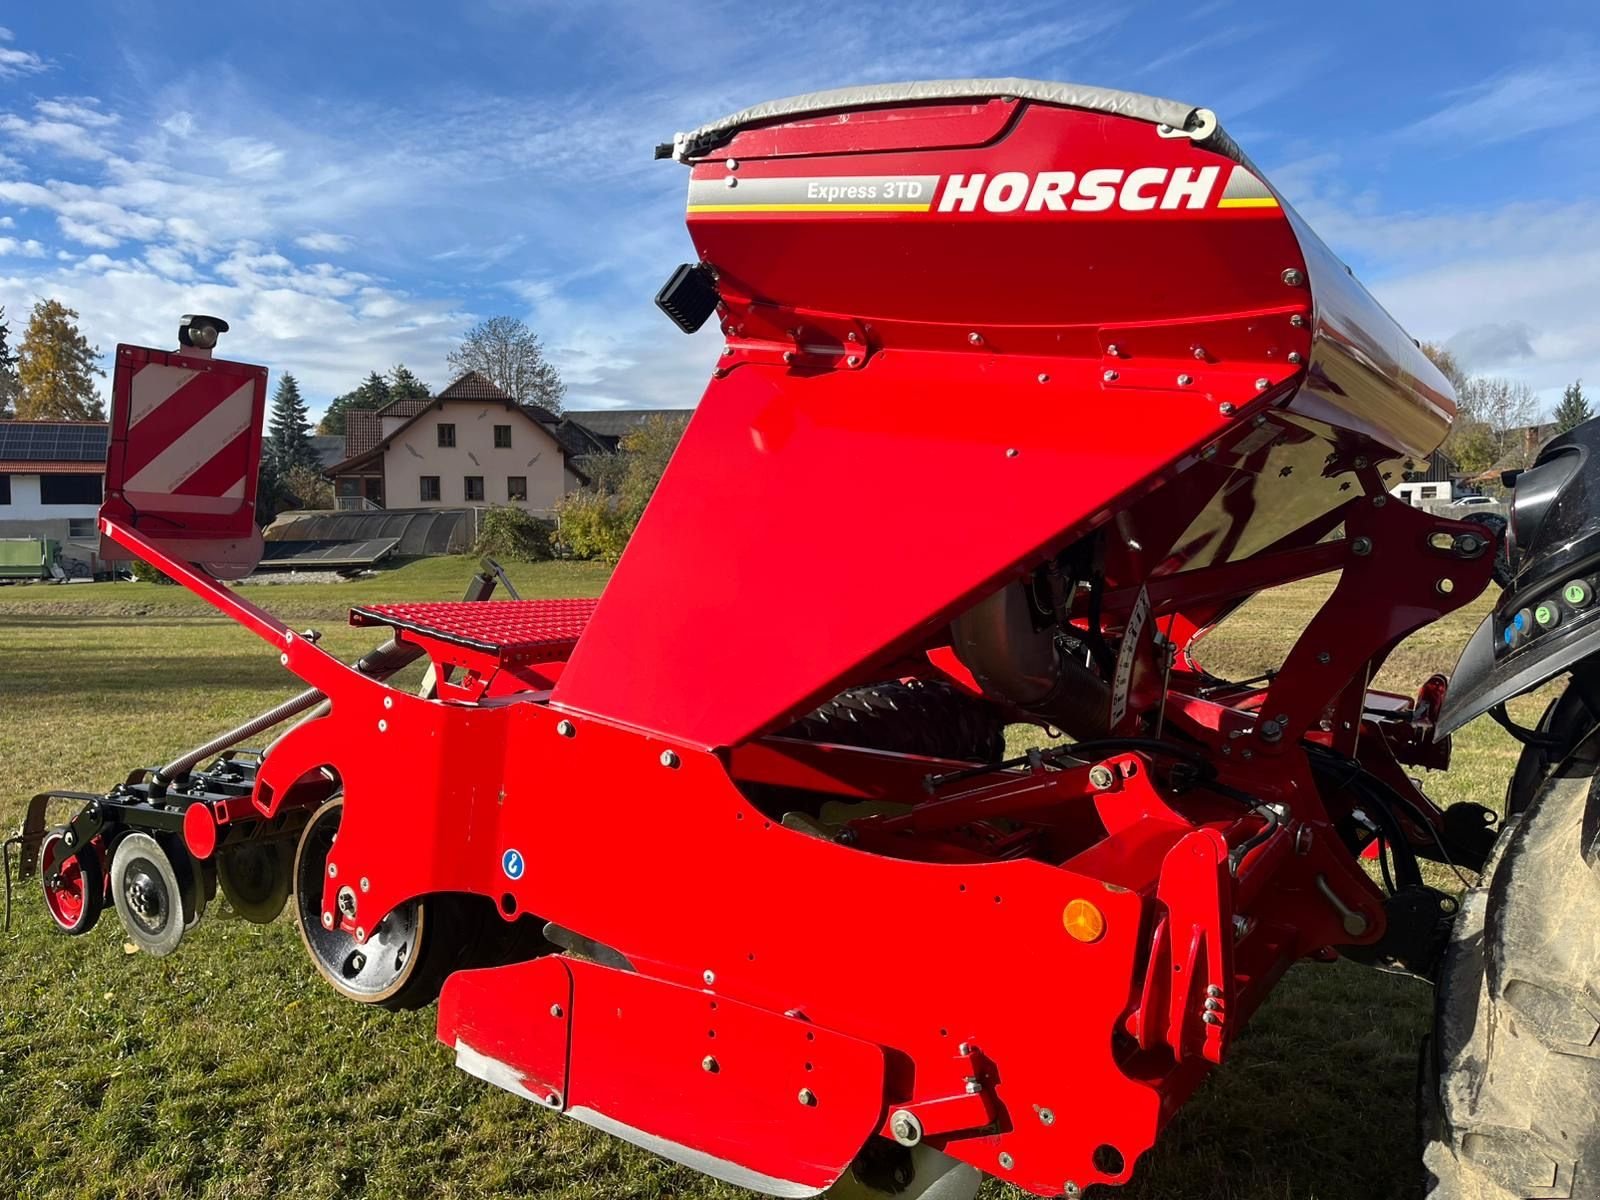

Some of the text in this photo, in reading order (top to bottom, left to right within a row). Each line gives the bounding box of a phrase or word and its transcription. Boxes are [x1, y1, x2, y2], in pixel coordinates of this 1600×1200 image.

[807, 181, 922, 202] Express 3TD
[937, 166, 1220, 212] HORSCH
